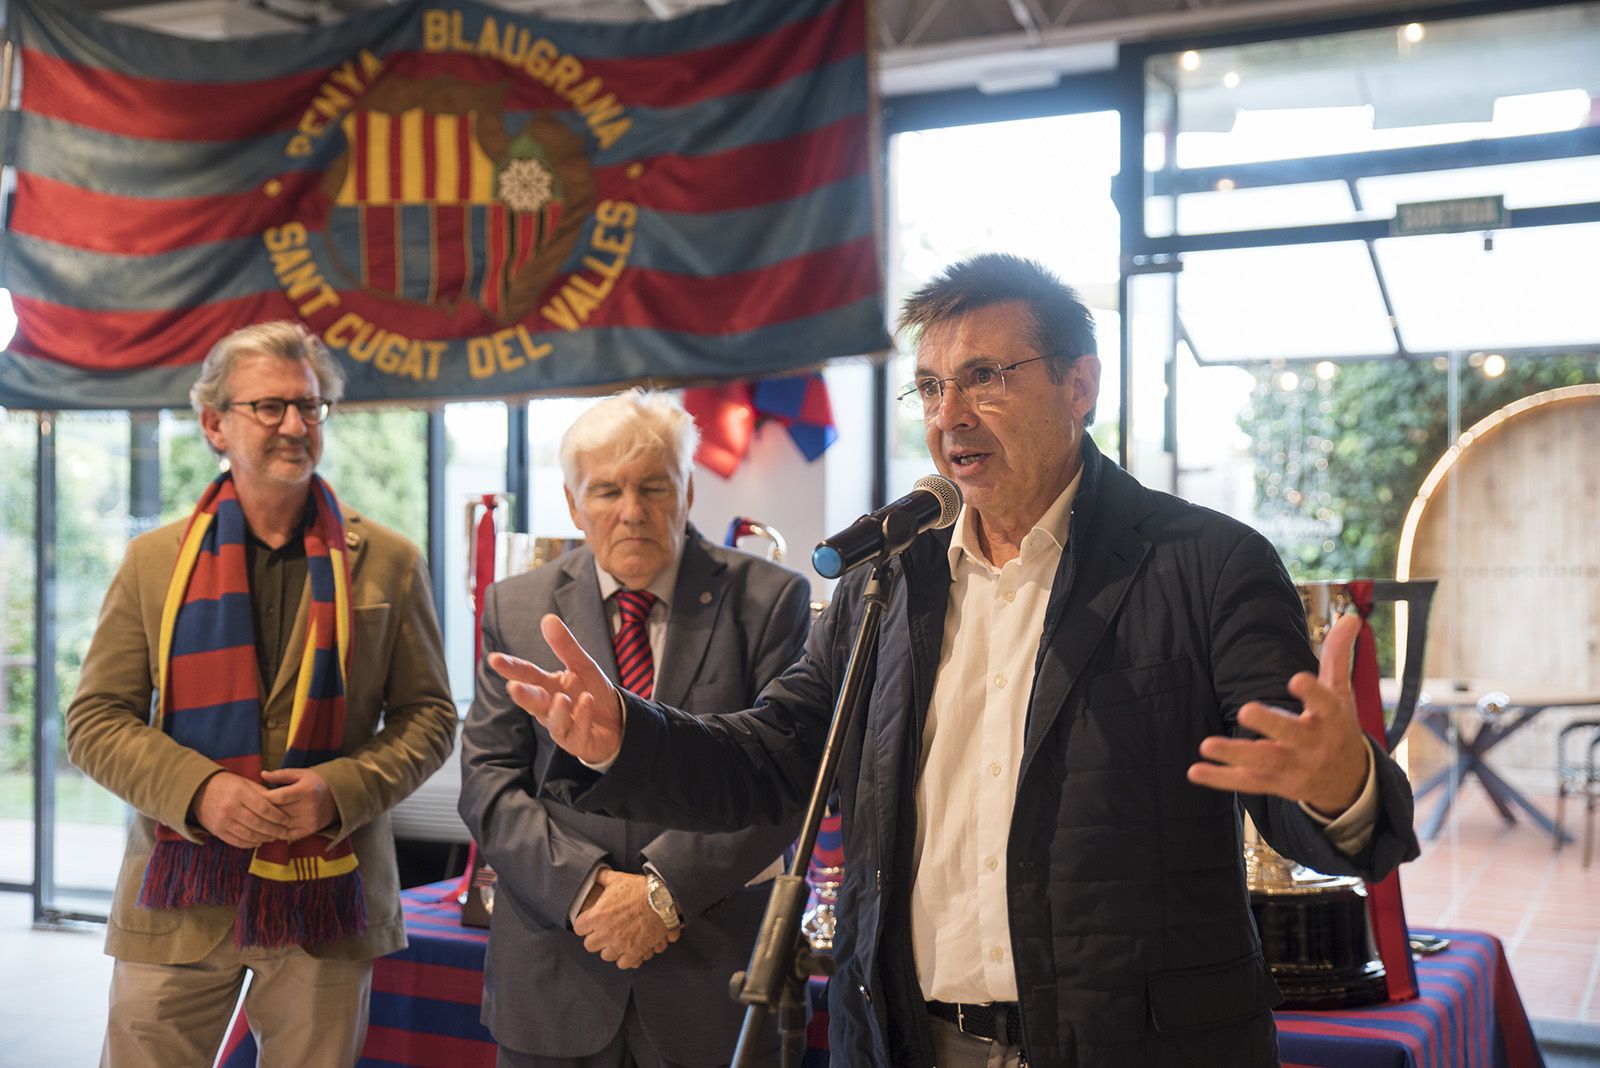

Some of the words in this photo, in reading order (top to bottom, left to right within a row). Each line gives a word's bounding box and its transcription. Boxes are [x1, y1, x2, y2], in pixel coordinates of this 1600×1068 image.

[423, 10, 633, 149] BLAUGRANA
[263, 222, 340, 318] SANT
[324, 312, 448, 381] CUGAT
[467, 324, 553, 379] DEL
[541, 199, 638, 332] VALLES
